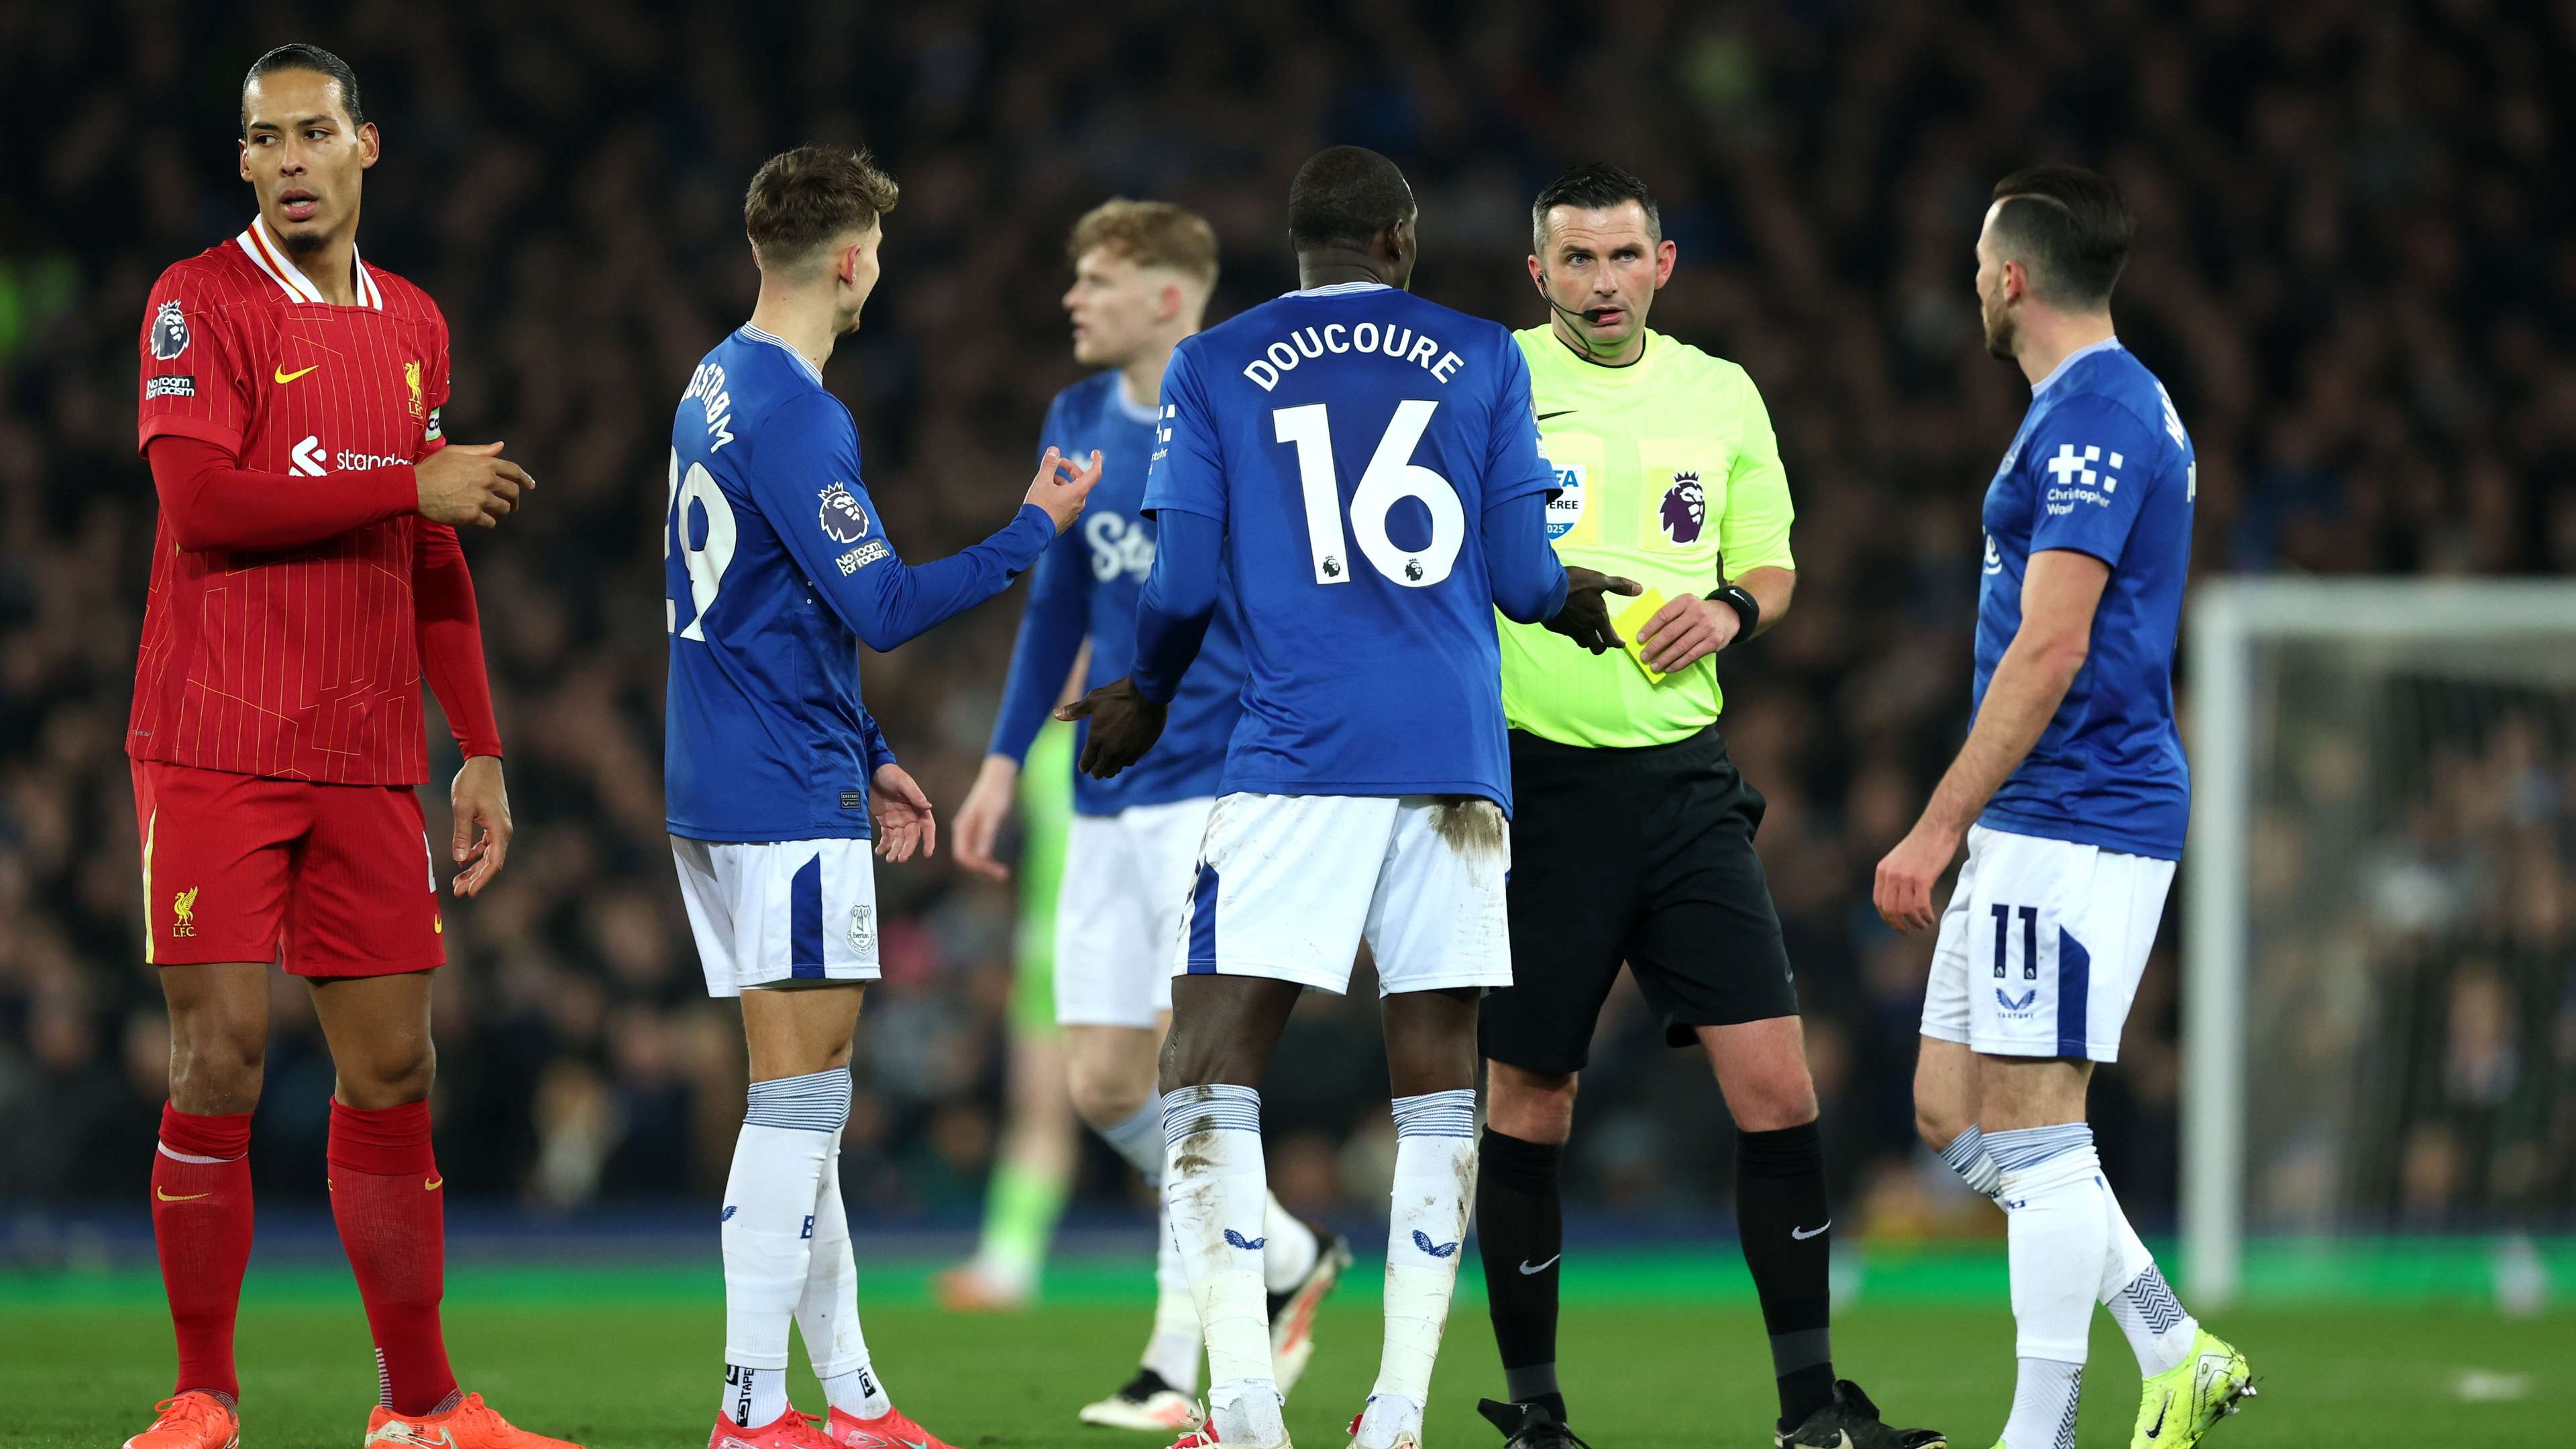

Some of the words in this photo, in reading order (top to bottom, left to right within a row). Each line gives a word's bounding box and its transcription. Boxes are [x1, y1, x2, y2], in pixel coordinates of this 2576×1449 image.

[1243, 323, 1464, 392] DOUCOURE
[147, 378, 158, 389] No
[159, 377, 190, 387] room
[157, 386, 195, 397] racism
[680, 363, 735, 453] DSTRØM
[1554, 470, 1578, 487] FA
[1273, 400, 1464, 588] 16
[1550, 500, 1578, 509] EREE
[1547, 525, 1564, 533] 025
[665, 445, 737, 642] 9
[835, 553, 854, 568] No
[853, 542, 881, 559] room
[857, 549, 890, 568] racism
[1991, 904, 2037, 979] 11
